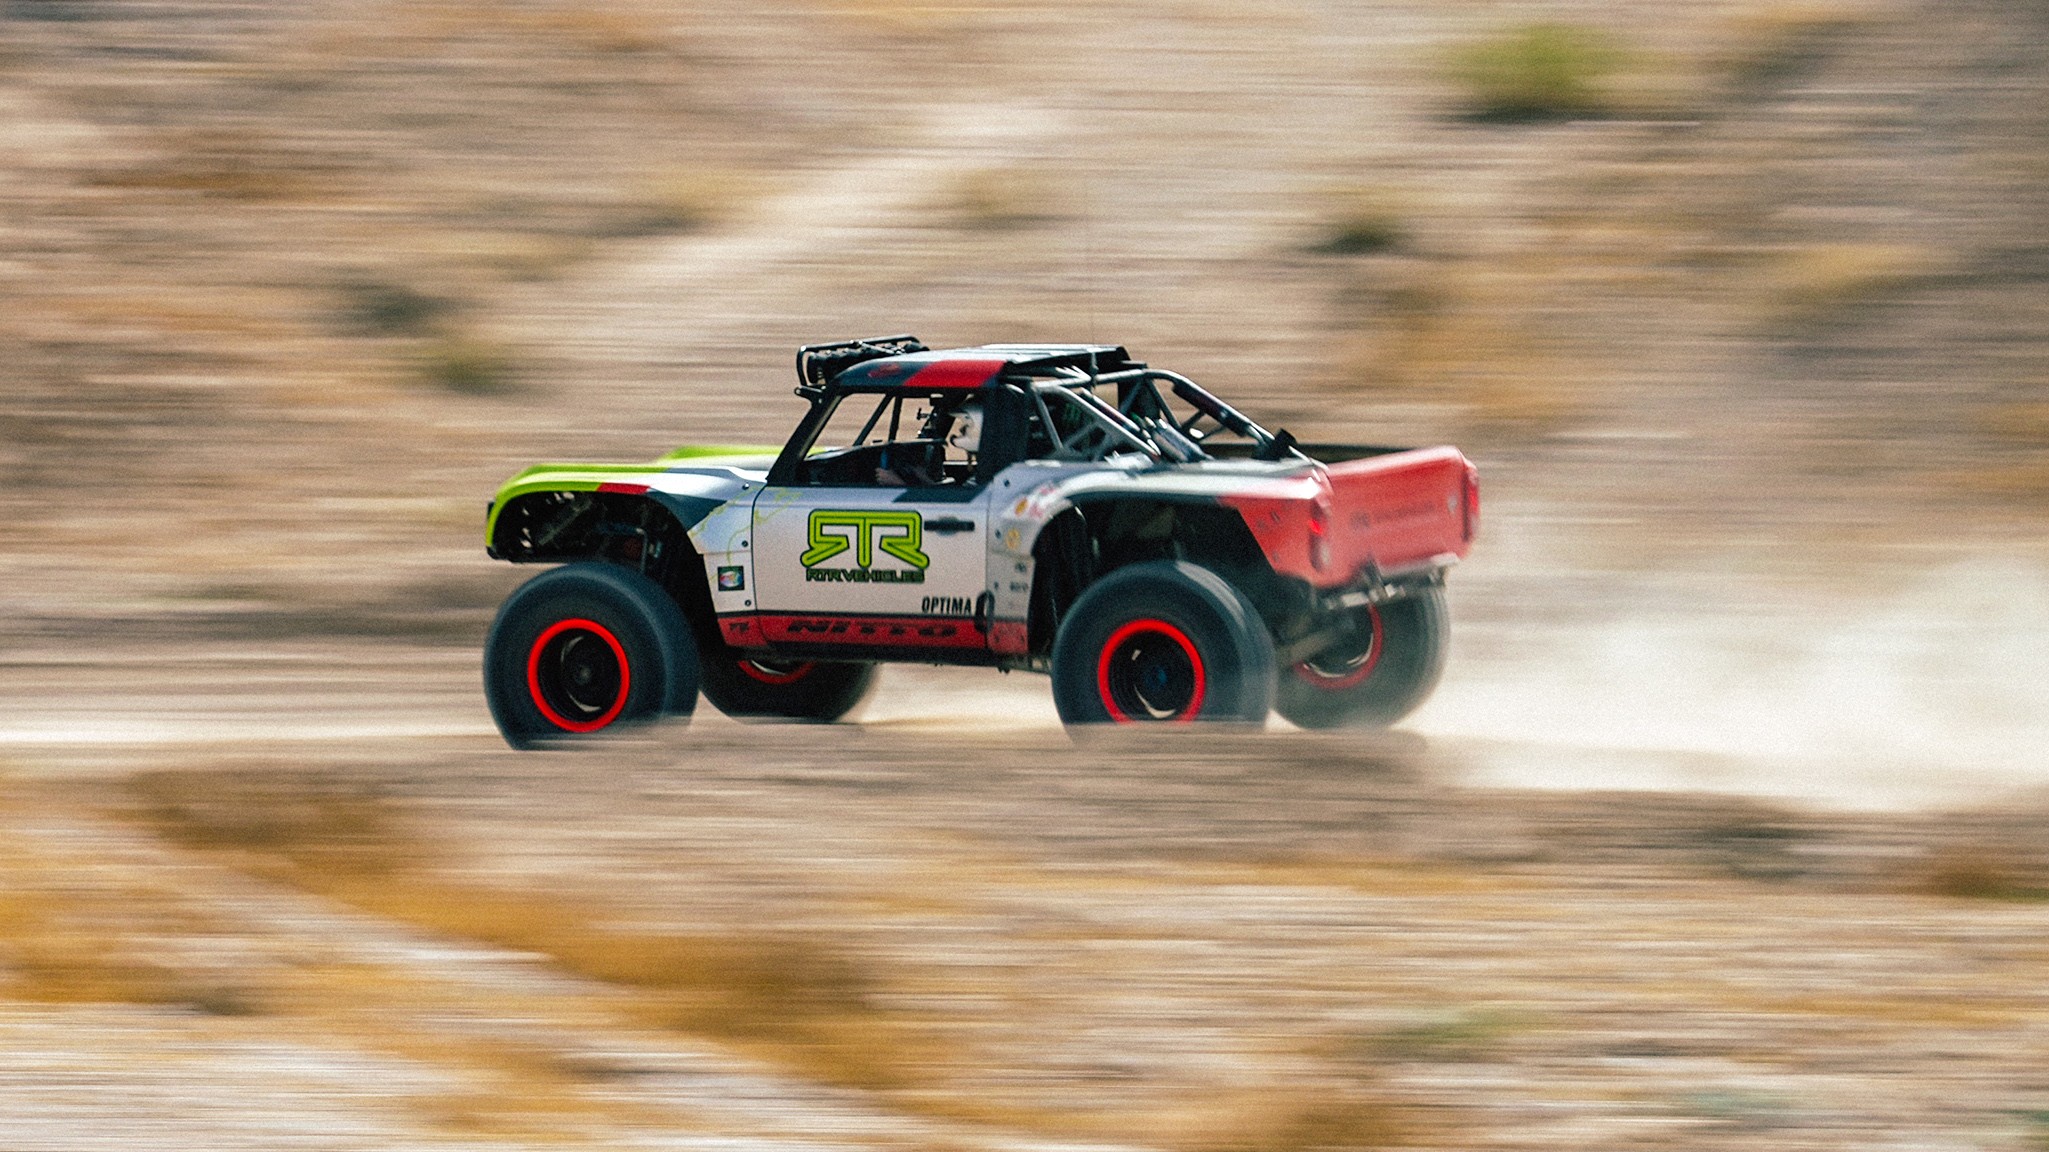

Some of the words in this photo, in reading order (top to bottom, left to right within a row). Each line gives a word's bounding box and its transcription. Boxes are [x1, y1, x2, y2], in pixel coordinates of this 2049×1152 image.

[799, 508, 930, 570] RTR
[922, 595, 972, 614] OPTIMA
[787, 620, 957, 637] NITTO
